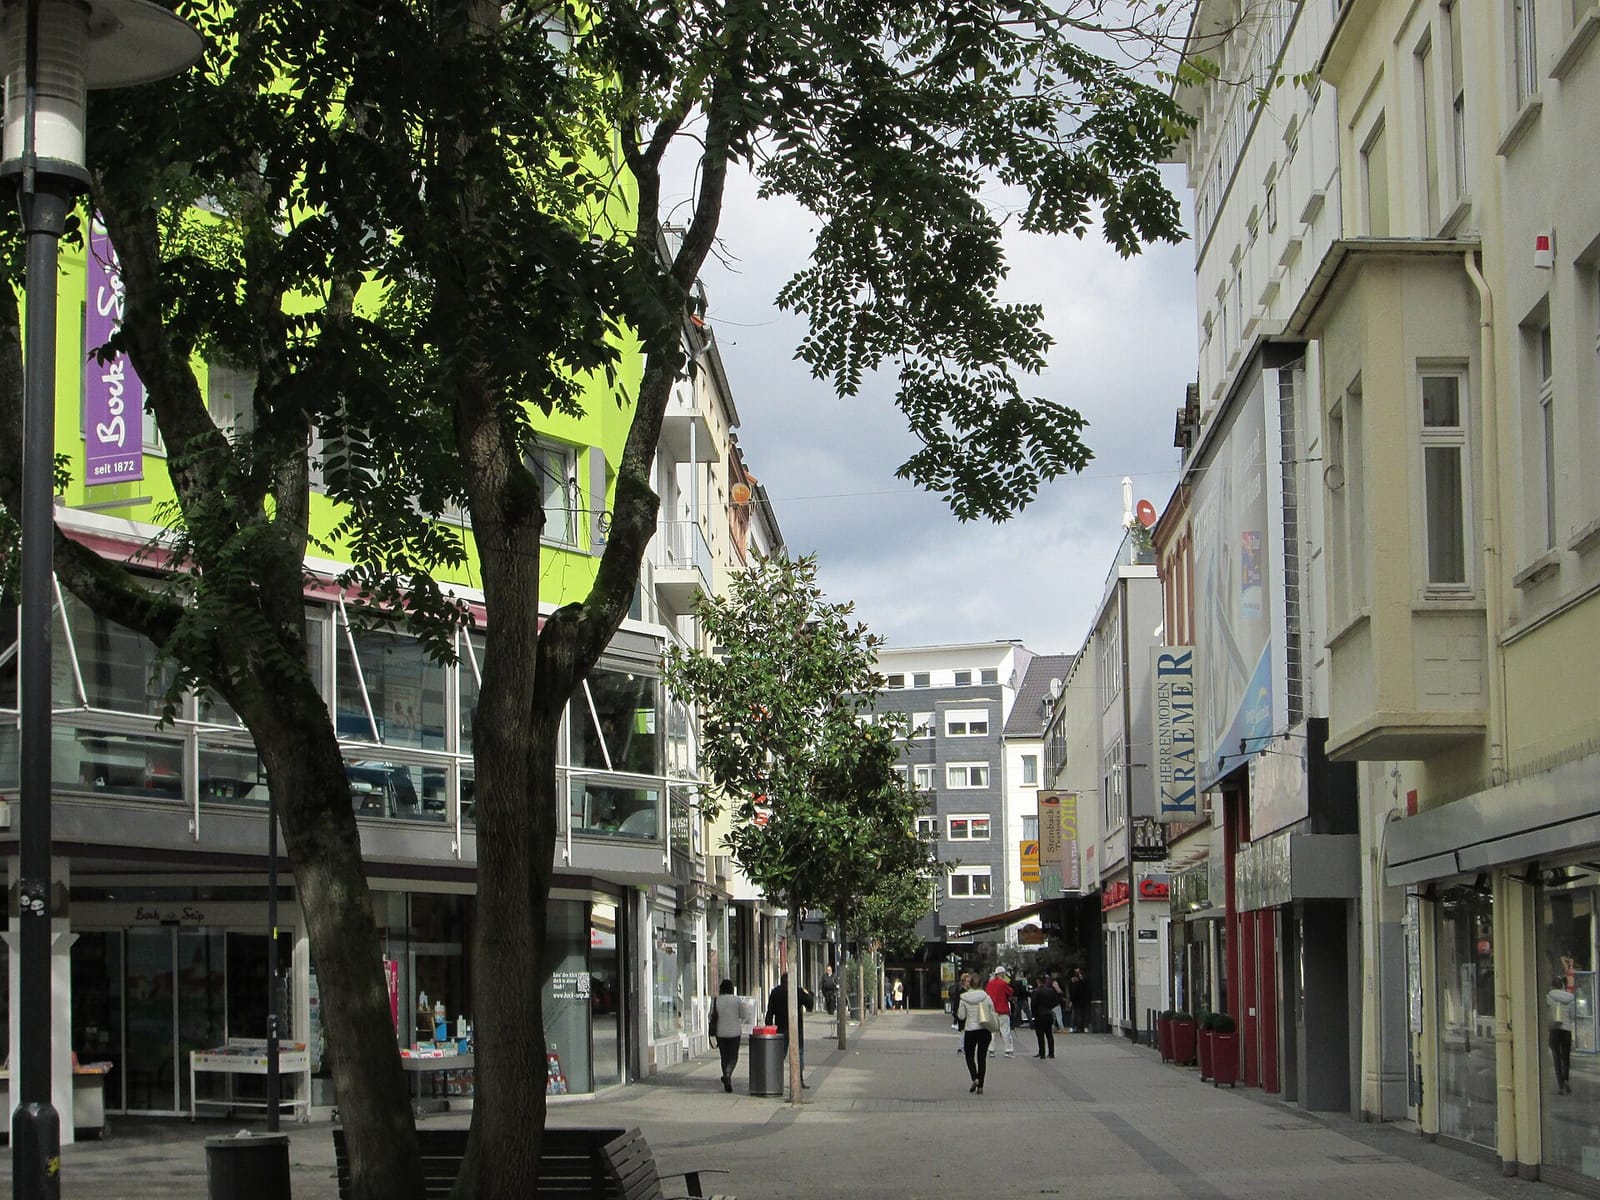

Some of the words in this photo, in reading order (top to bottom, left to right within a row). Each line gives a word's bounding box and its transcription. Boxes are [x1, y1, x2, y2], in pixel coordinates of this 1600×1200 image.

[94, 463, 111, 475] seit
[114, 460, 134, 473] 1872
[1157, 650, 1196, 815] KRAEMER
[1157, 682, 1172, 784] HERRENMODEN
[1047, 808, 1055, 853] Steinback
